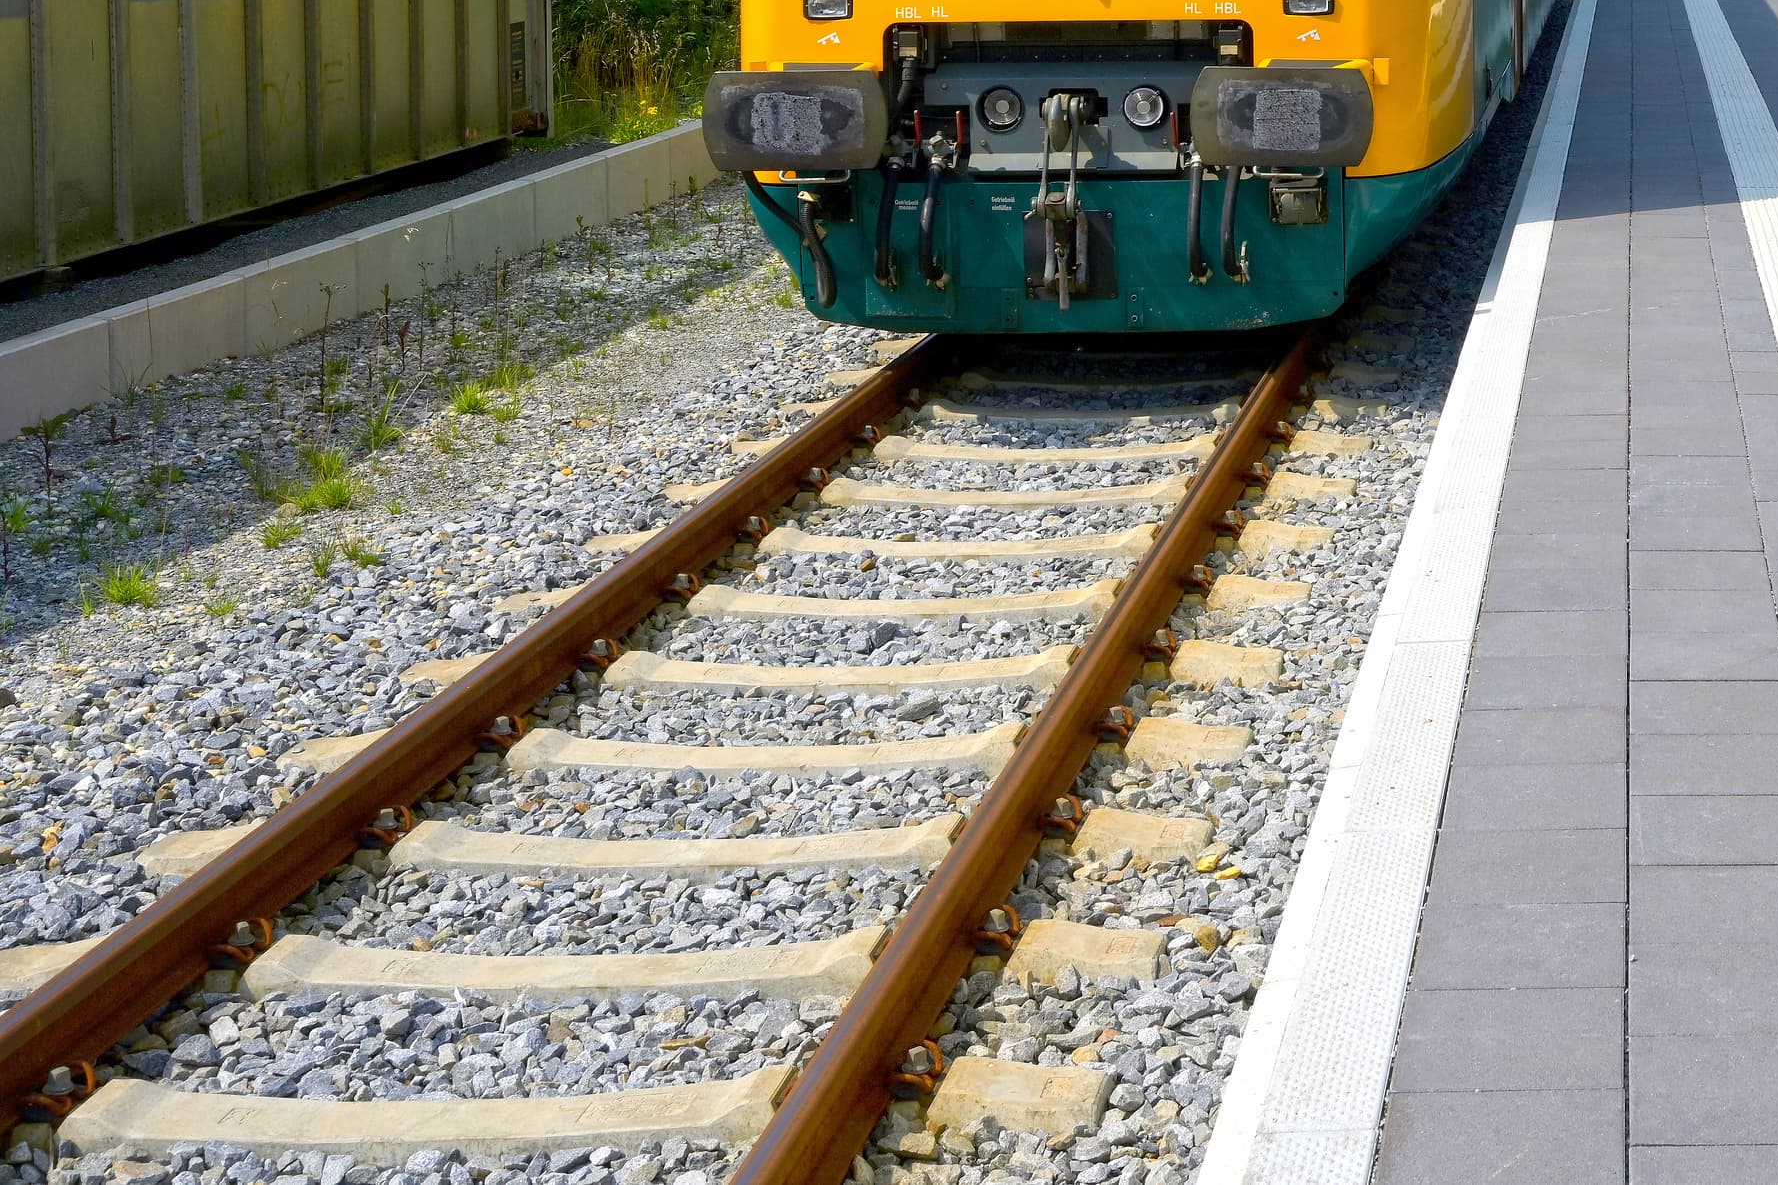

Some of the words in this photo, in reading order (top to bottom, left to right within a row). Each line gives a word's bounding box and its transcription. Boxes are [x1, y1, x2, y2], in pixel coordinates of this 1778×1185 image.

[895, 6, 922, 19] HBL
[931, 6, 950, 18] HL
[1184, 2, 1203, 14] HL
[1215, 2, 1241, 14] HBL
